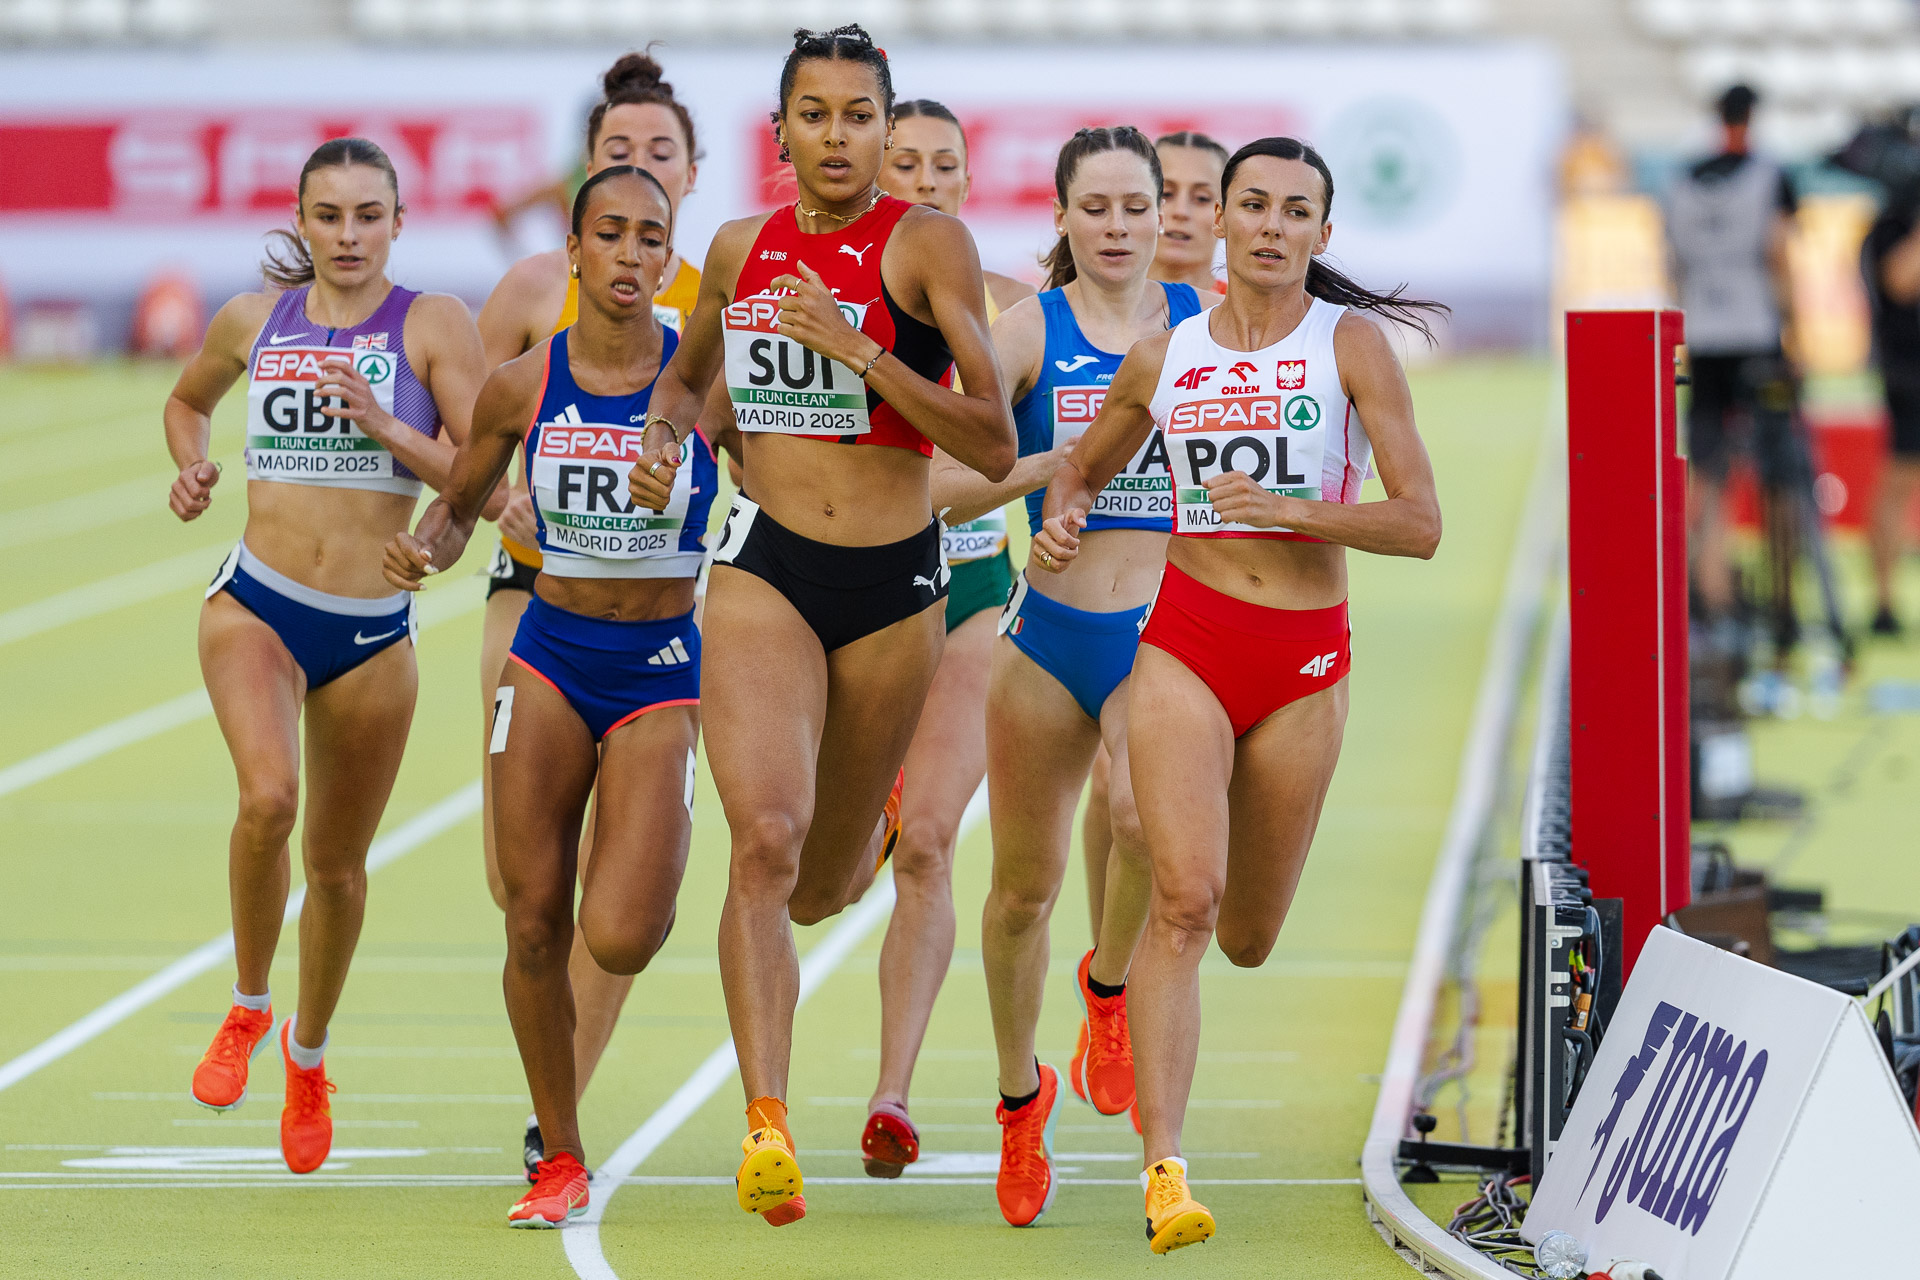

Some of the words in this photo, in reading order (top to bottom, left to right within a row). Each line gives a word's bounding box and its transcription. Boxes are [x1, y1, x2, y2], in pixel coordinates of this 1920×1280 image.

[769, 251, 787, 261] UBS
[749, 339, 834, 391] SUI
[1174, 366, 1218, 391] 4F
[749, 390, 753, 402] I
[756, 390, 783, 404] RUN
[1221, 385, 1260, 396] ORLEN
[733, 408, 805, 428] MADRID
[810, 413, 856, 429] 2025
[1172, 399, 1278, 431] SPAR
[274, 437, 279, 449] I
[280, 437, 307, 450] RUN
[257, 455, 329, 472] MADRID
[334, 456, 379, 472] 2025
[1185, 435, 1305, 486] POL
[565, 514, 570, 525] I
[571, 515, 600, 528] RUN
[556, 526, 622, 552] MADRID
[628, 533, 667, 552] 2025
[1299, 650, 1338, 678] 4F
